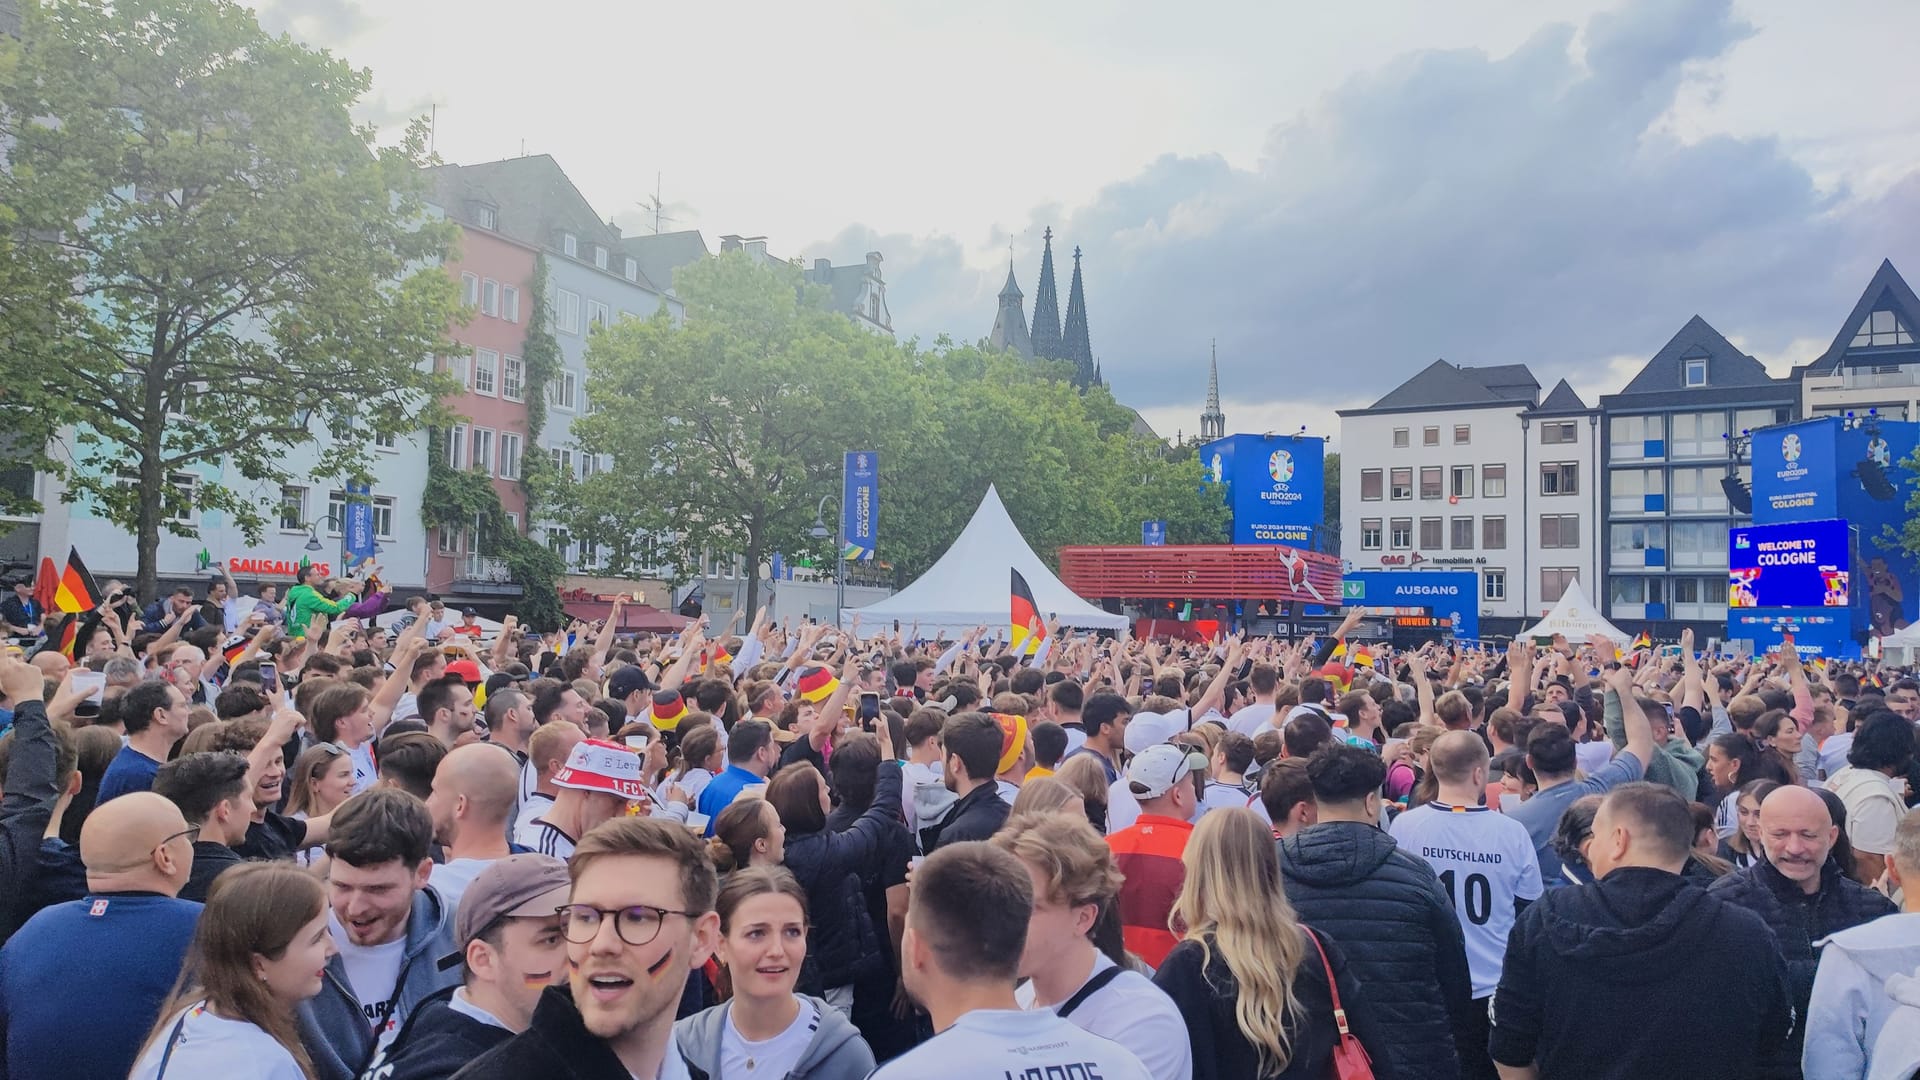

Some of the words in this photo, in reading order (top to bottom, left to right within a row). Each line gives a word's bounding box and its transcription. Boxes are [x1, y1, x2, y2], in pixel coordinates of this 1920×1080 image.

[858, 486, 862, 496] TO
[1261, 491, 1302, 501] EURO2024
[1772, 497, 1815, 509] COLOGNE
[1255, 530, 1308, 541] COLOGNE
[1758, 540, 1802, 552] WELCOME
[1803, 539, 1816, 549] TO
[1380, 555, 1405, 566] GAG
[1432, 557, 1473, 565] Immobilien
[1475, 557, 1487, 565] AG
[1758, 551, 1817, 567] COLOGNE
[1395, 586, 1459, 596] AUSGANG
[1422, 846, 1502, 864] DEUTSCHLAND
[1439, 869, 1492, 926] 10
